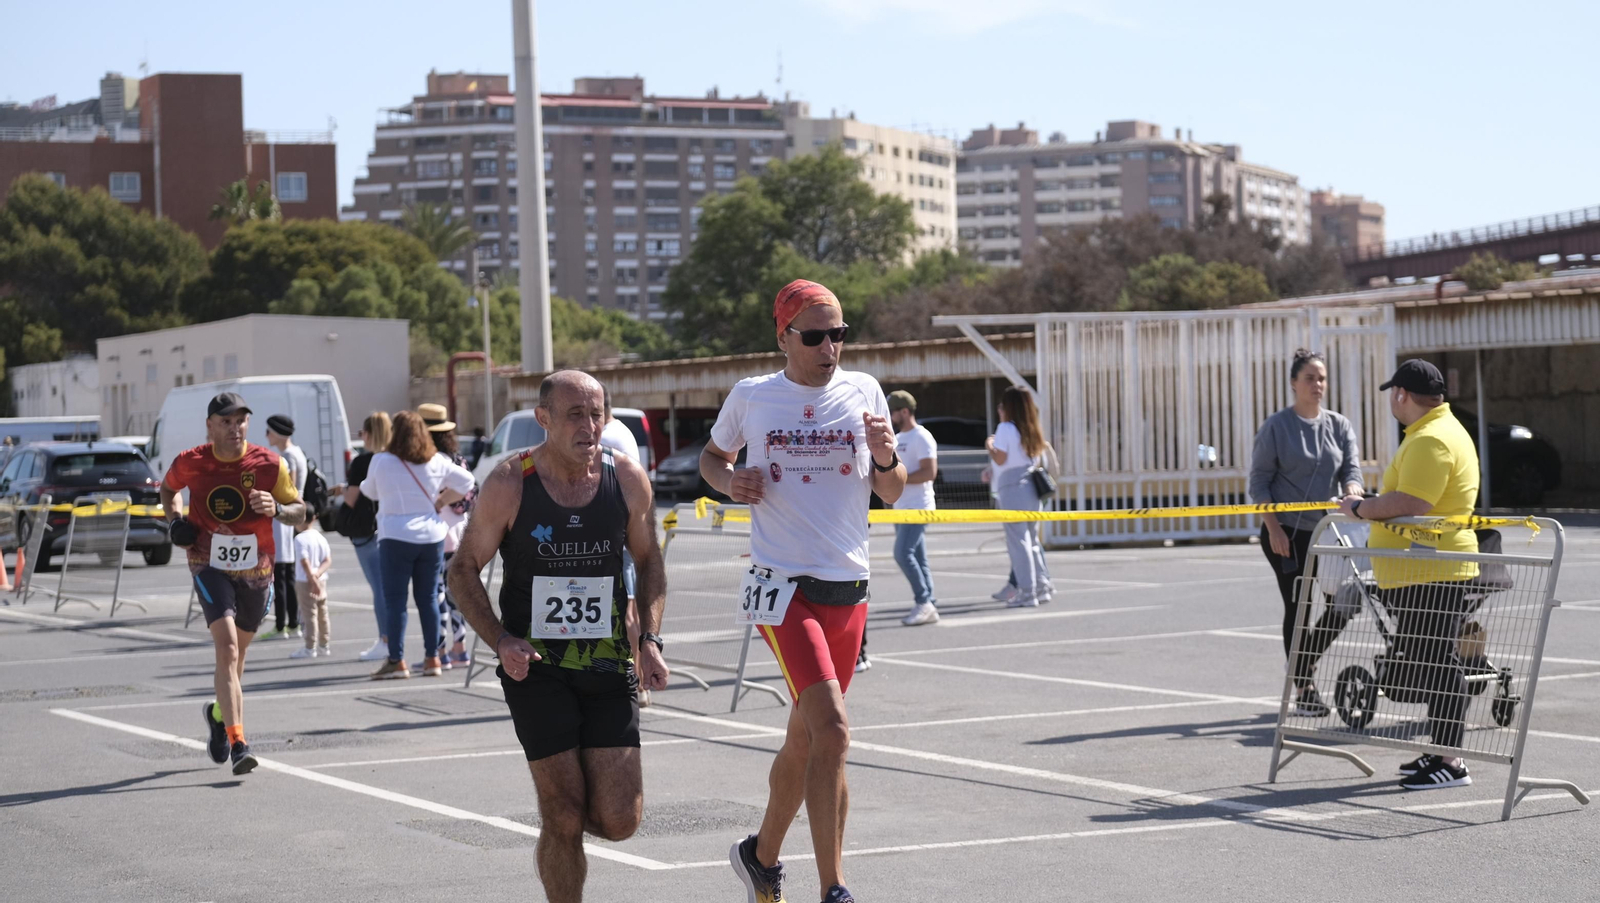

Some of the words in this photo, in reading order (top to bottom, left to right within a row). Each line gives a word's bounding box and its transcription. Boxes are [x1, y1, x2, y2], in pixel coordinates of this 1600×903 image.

[218, 546, 251, 562] 397
[537, 540, 611, 557] CUELLAR
[548, 561, 578, 569] STONE
[743, 585, 780, 611] 311
[545, 597, 602, 624] 235
